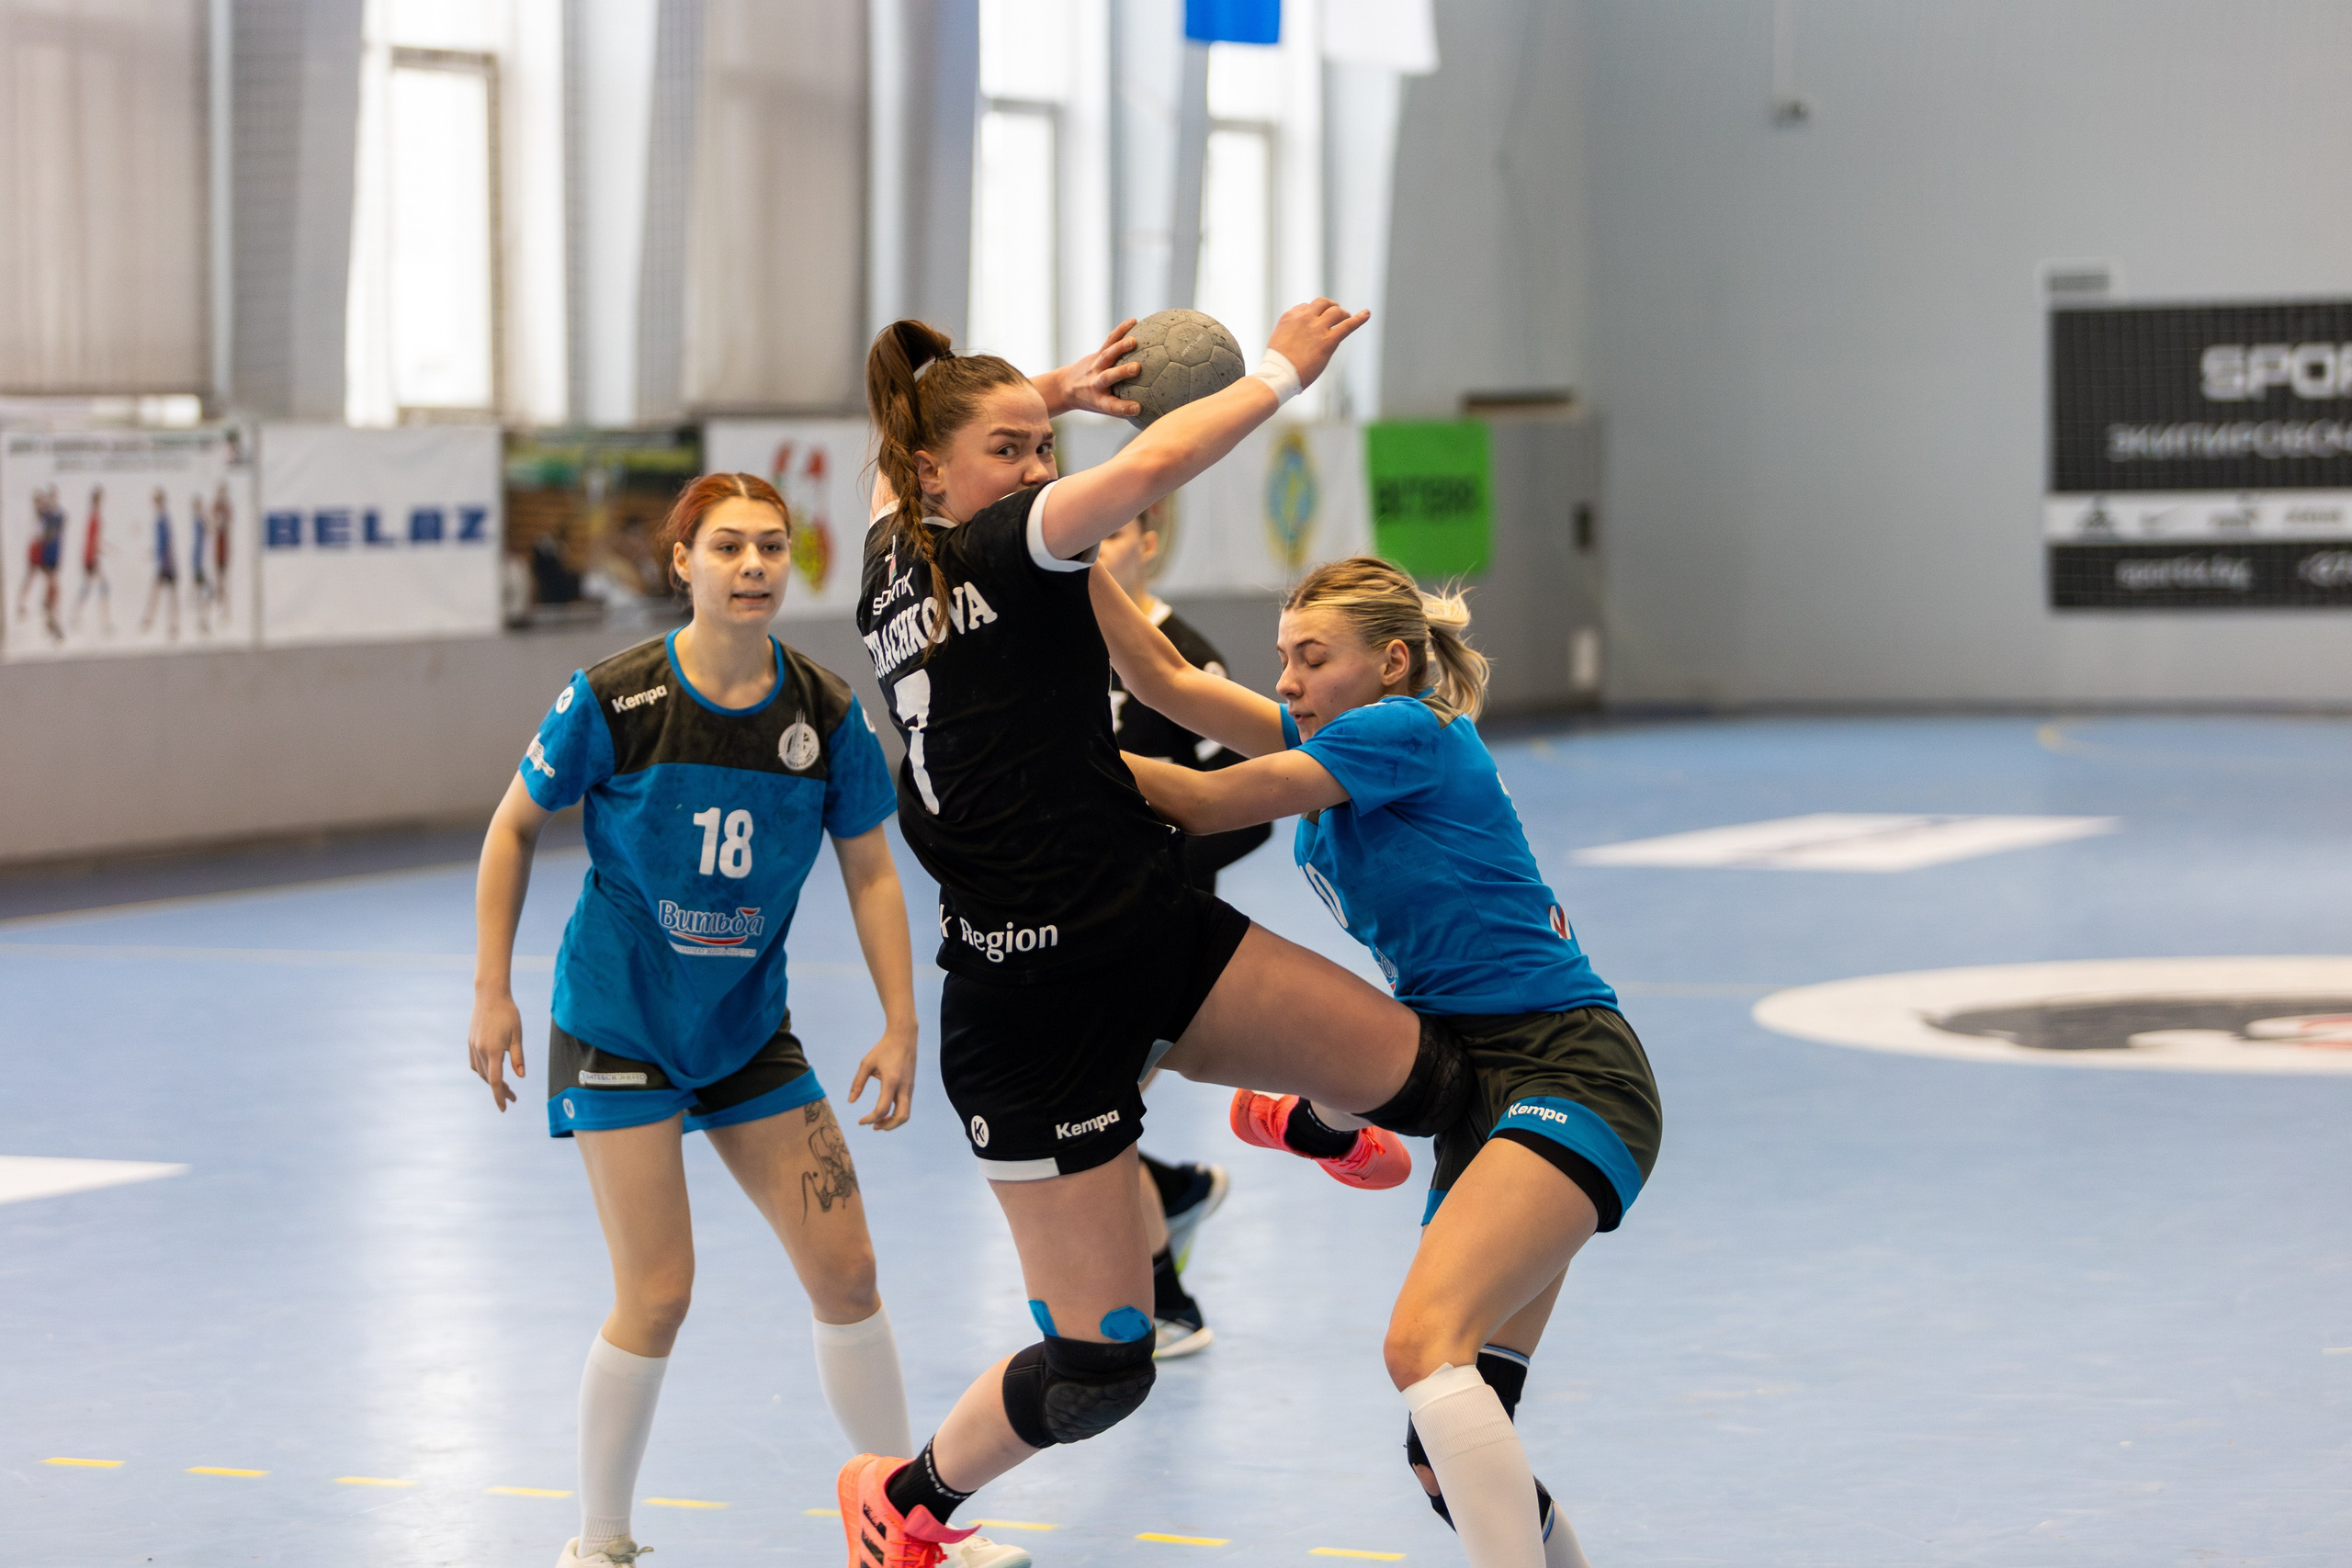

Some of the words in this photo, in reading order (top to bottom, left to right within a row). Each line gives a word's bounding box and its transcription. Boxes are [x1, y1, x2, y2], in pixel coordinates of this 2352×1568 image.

[265, 506, 488, 547] BELAZ
[611, 684, 668, 714] Kempa
[893, 668, 940, 815] 7
[693, 807, 754, 879] 18
[960, 916, 1058, 964] Region
[1056, 1109, 1120, 1140] Kempa
[1508, 1102, 1568, 1124] Kempa
